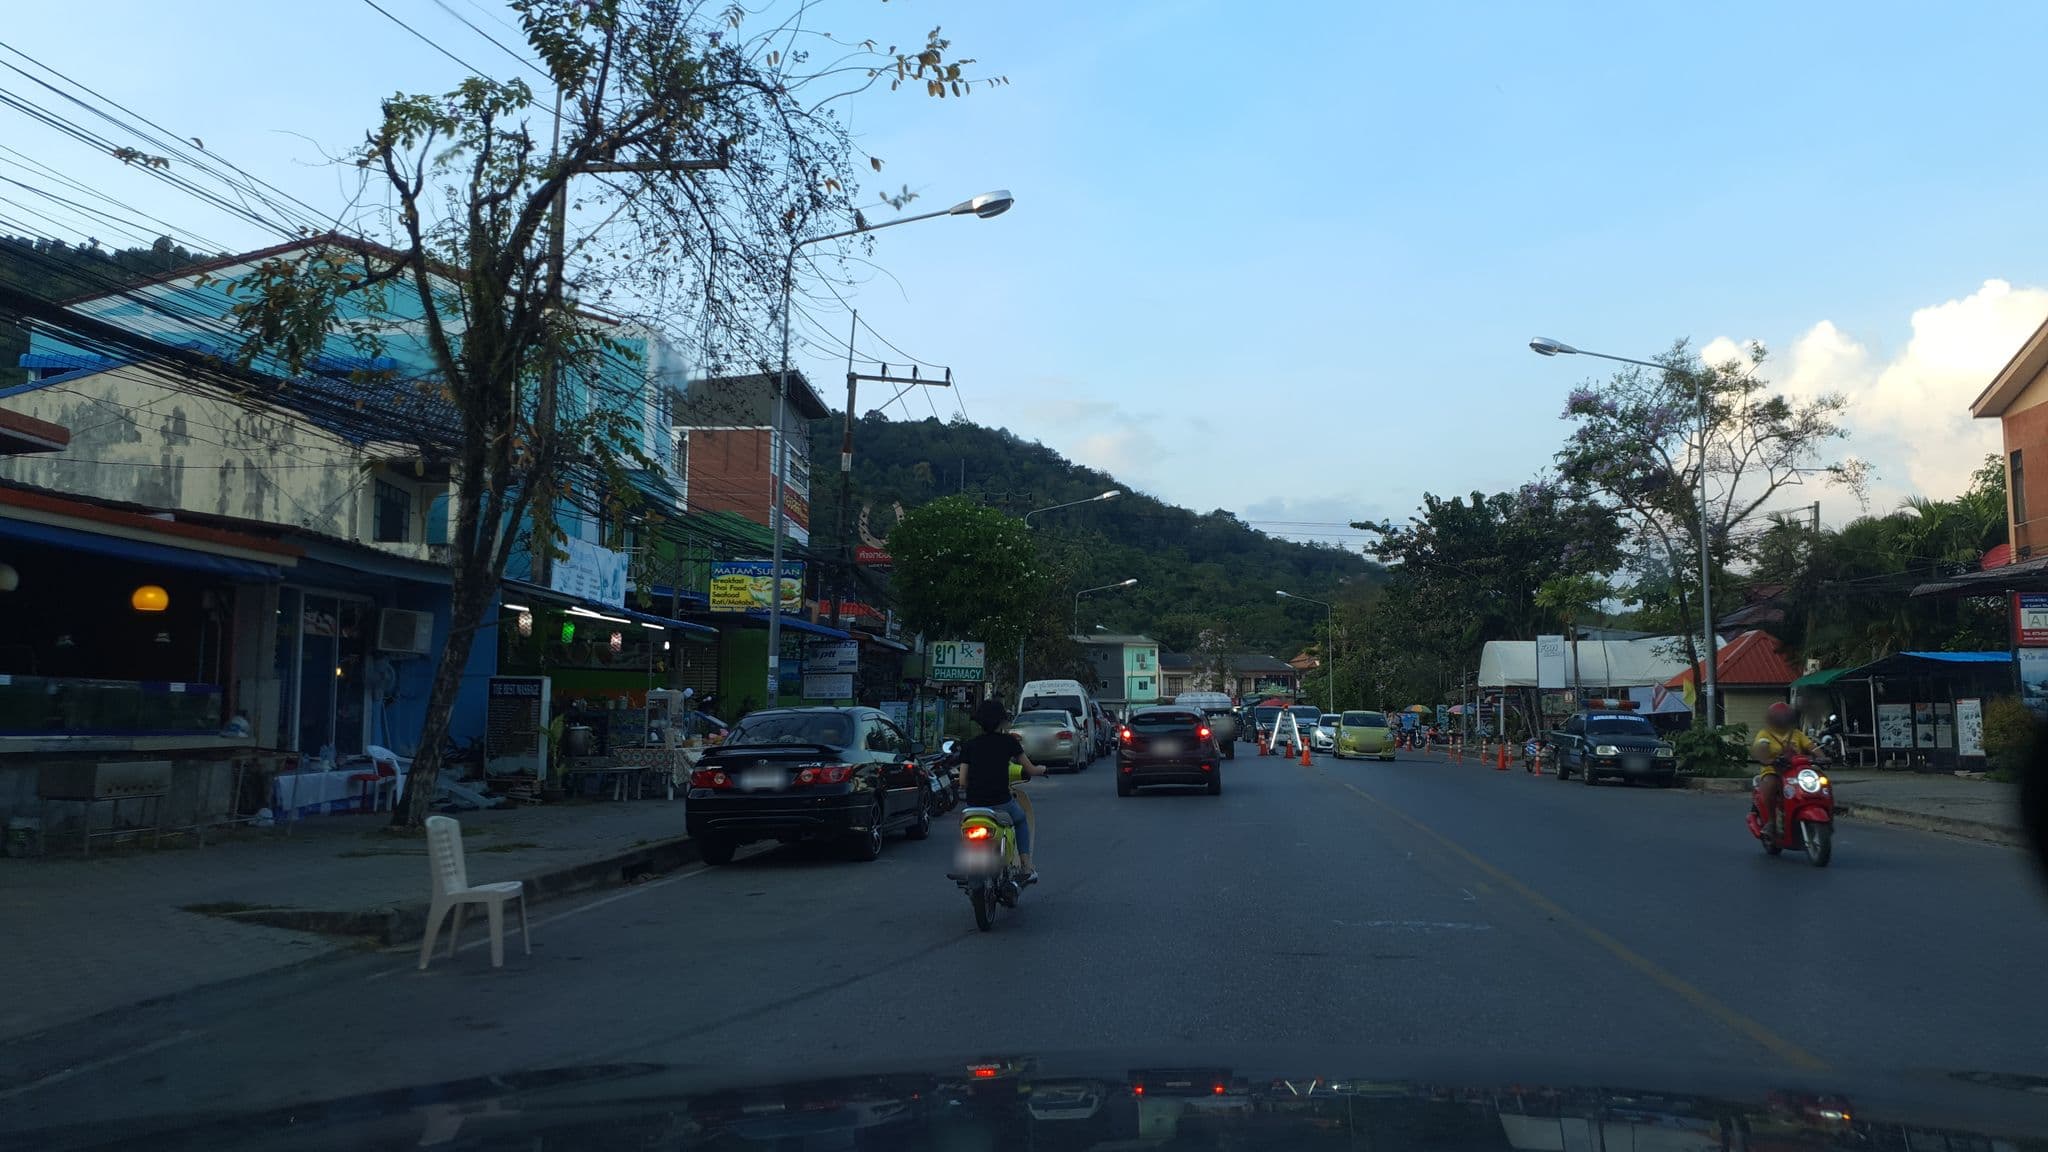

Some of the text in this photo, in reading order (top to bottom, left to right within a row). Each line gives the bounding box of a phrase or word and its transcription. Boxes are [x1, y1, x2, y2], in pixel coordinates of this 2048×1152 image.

[713, 567, 753, 575] MATAM
[935, 644, 956, 665] ยา
[934, 668, 982, 680] PHARMACY
